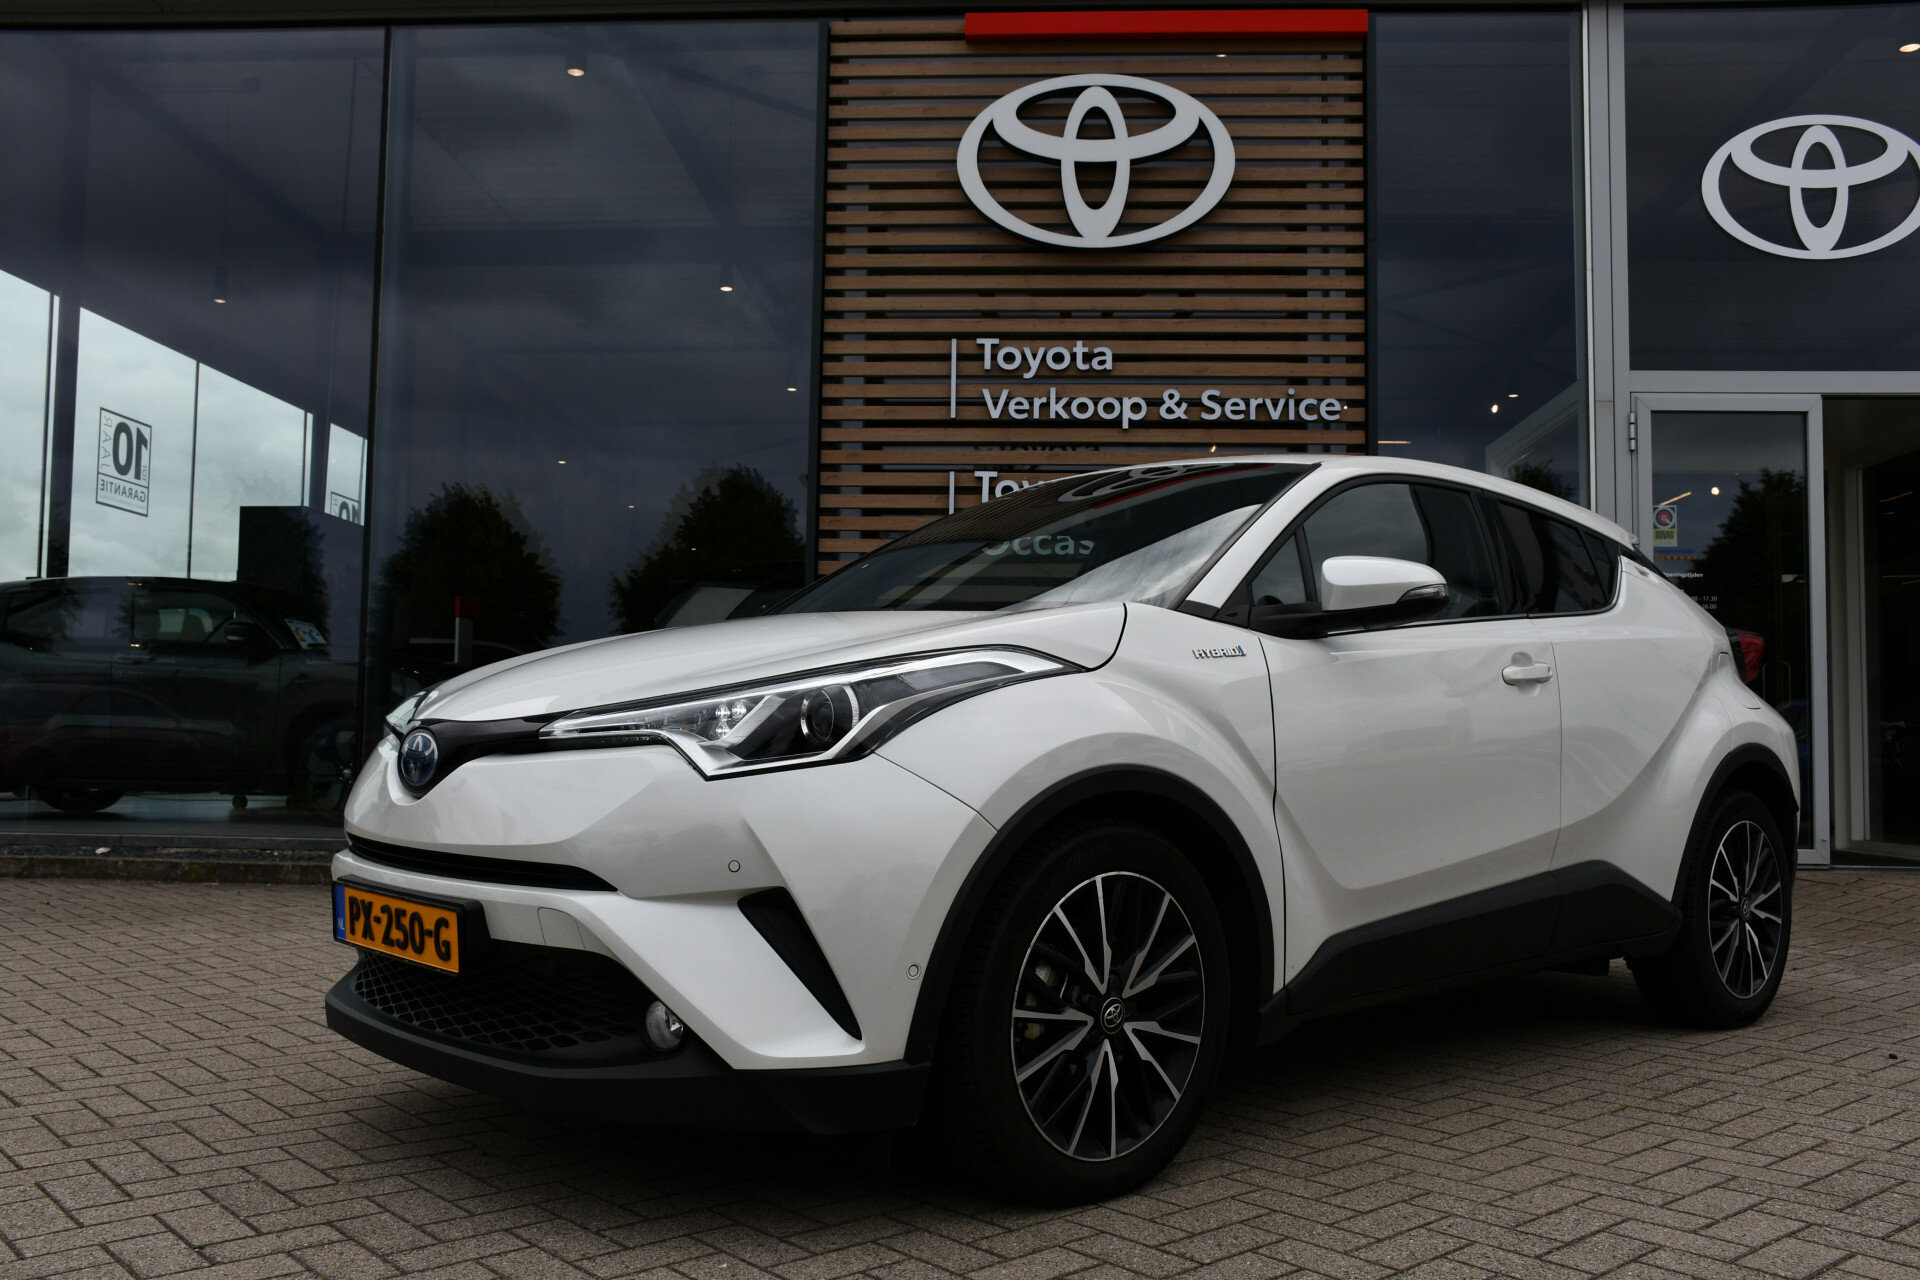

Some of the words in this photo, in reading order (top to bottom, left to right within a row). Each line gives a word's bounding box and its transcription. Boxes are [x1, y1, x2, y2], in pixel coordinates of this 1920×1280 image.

[976, 338, 1113, 379] Toyota
[981, 388, 1147, 429] Verkoop
[1159, 390, 1188, 420] &
[1201, 388, 1342, 421] Service
[1192, 646, 1241, 659] HYBRID
[337, 917, 345, 930] NL
[348, 895, 451, 962] PX-250-G
